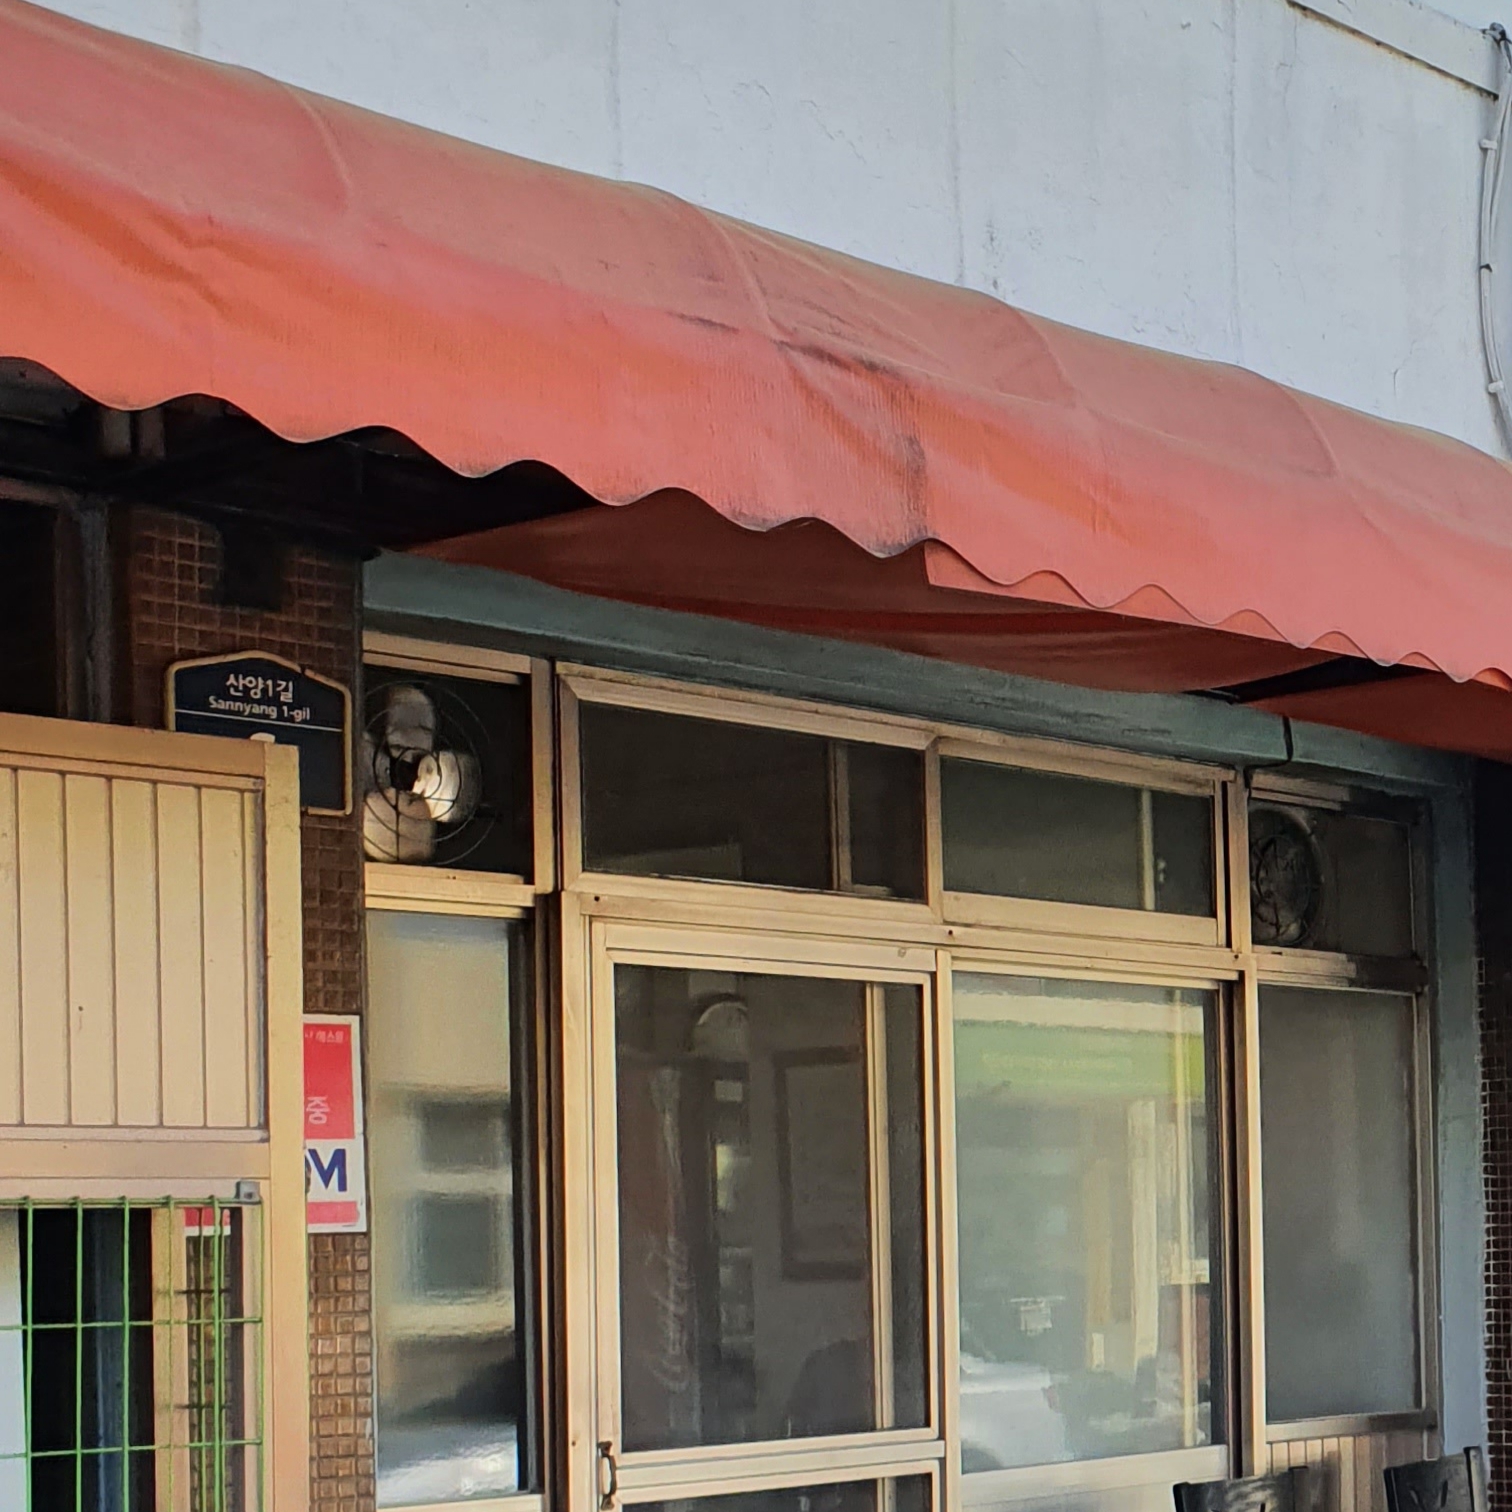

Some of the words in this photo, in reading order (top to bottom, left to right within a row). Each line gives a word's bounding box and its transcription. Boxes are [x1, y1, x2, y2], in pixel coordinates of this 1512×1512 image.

[226, 673, 294, 703] 산양1길
[208, 695, 278, 719] Sannyang
[282, 705, 311, 722] 1-gil
